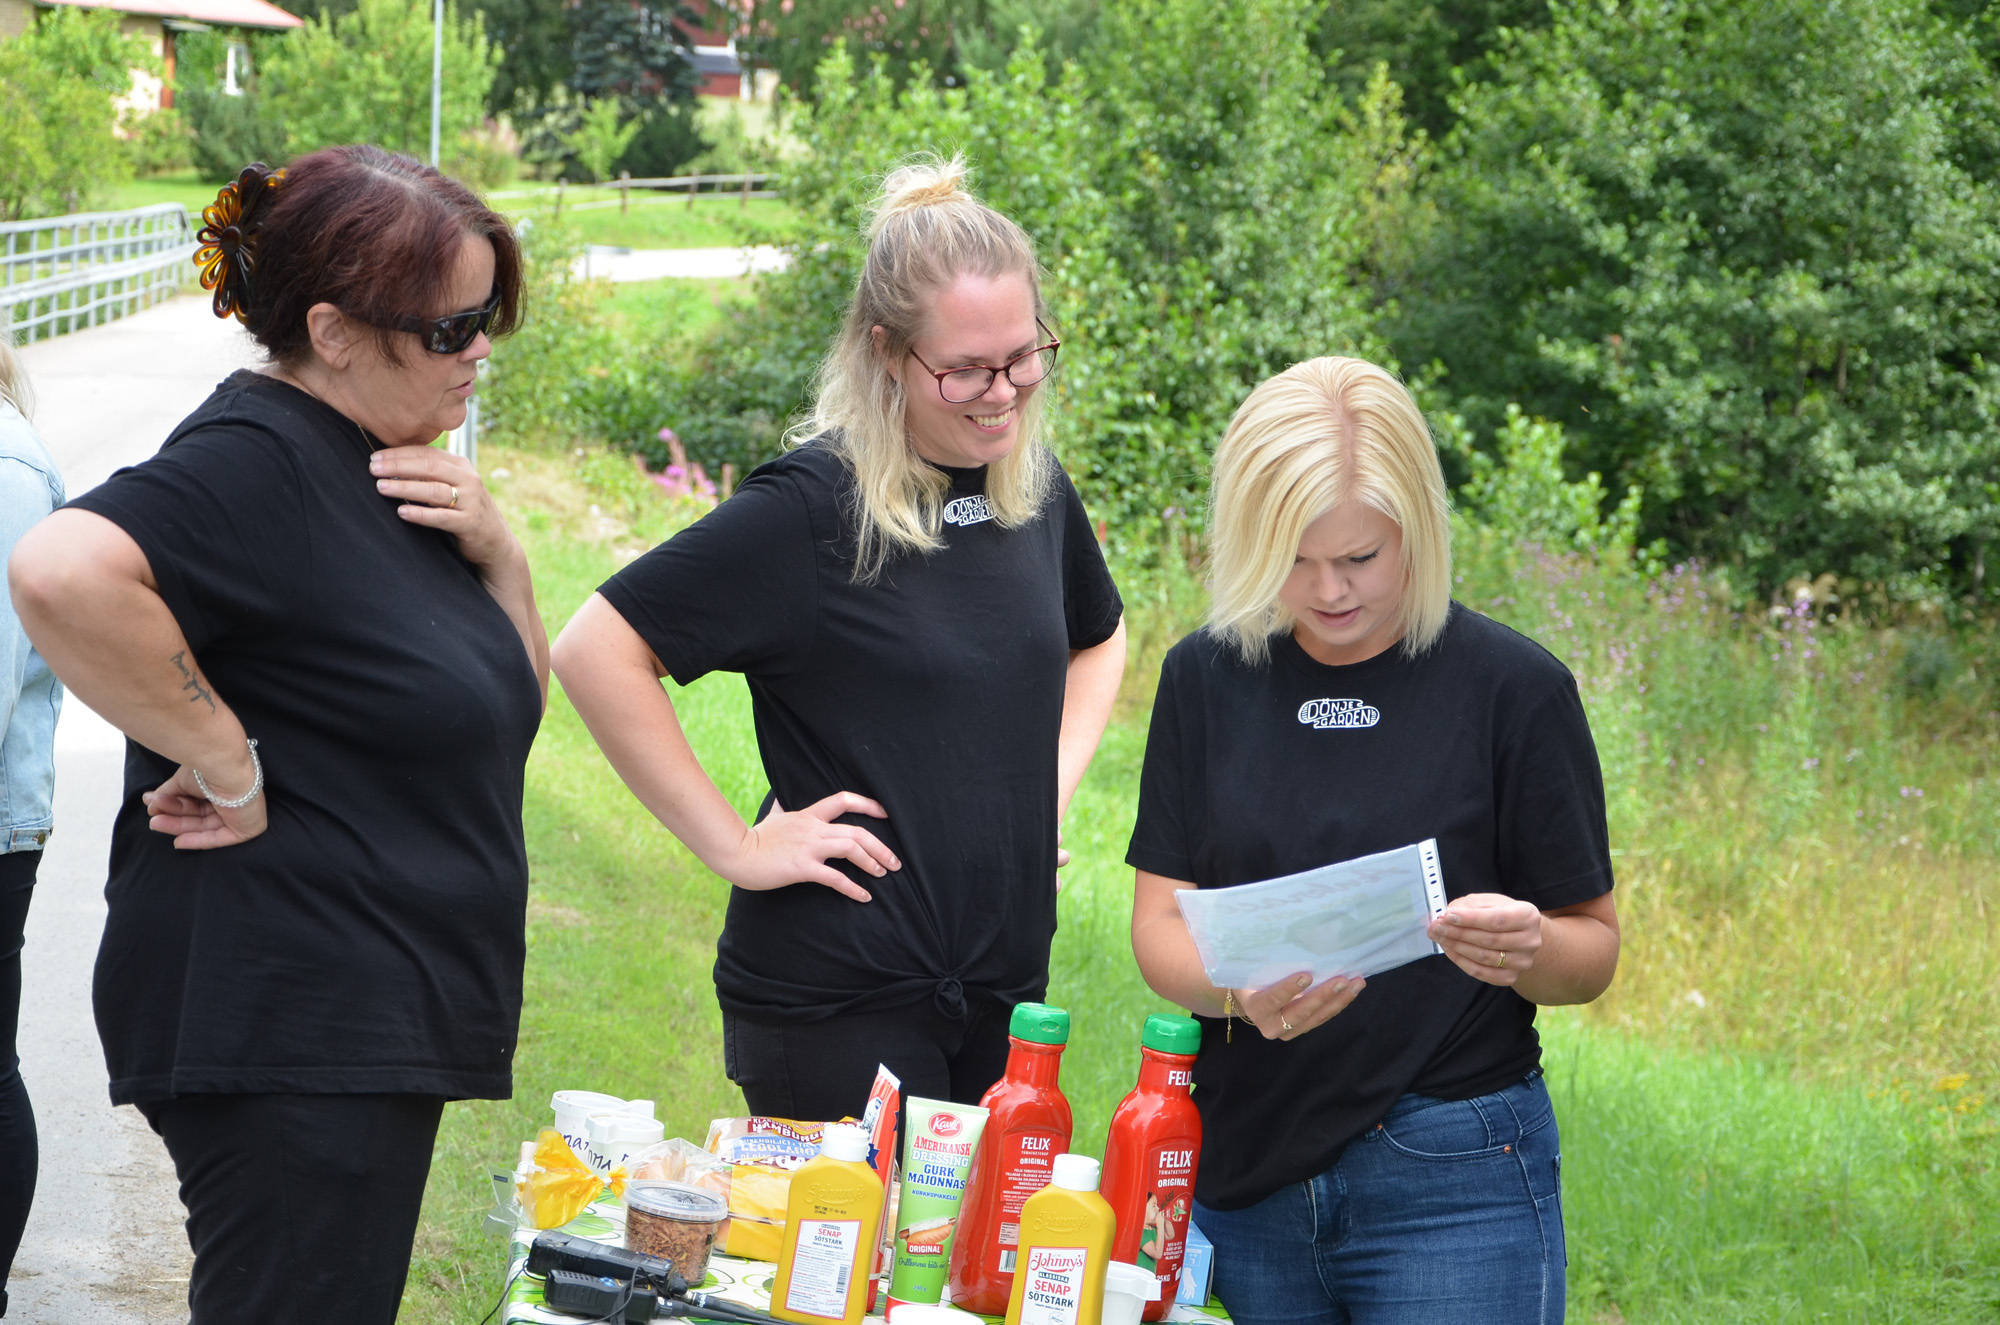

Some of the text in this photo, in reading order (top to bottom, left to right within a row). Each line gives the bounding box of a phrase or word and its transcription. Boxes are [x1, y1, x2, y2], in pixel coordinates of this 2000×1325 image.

[1308, 698, 1354, 720] DÖNJE
[933, 1116, 959, 1132] Kavli
[914, 1135, 972, 1156] AMERIKANSK
[1021, 1137, 1051, 1151] FELIX
[912, 1150, 969, 1167] DRESSING
[1020, 1158, 1048, 1166] ORIGINAL
[1159, 1150, 1193, 1168] FELIX
[924, 1164, 955, 1177] GURK
[908, 1172, 966, 1189] MAJONNÄS
[1158, 1178, 1188, 1188] ORIGINAL
[814, 1235, 842, 1246] SÖTSTARK
[818, 1228, 842, 1238] SENAP
[909, 1245, 940, 1253] ORIGINAL
[1030, 1252, 1083, 1272] Johnny's
[1034, 1280, 1071, 1295] SENAP
[1028, 1290, 1074, 1308] SÖTSTARK
